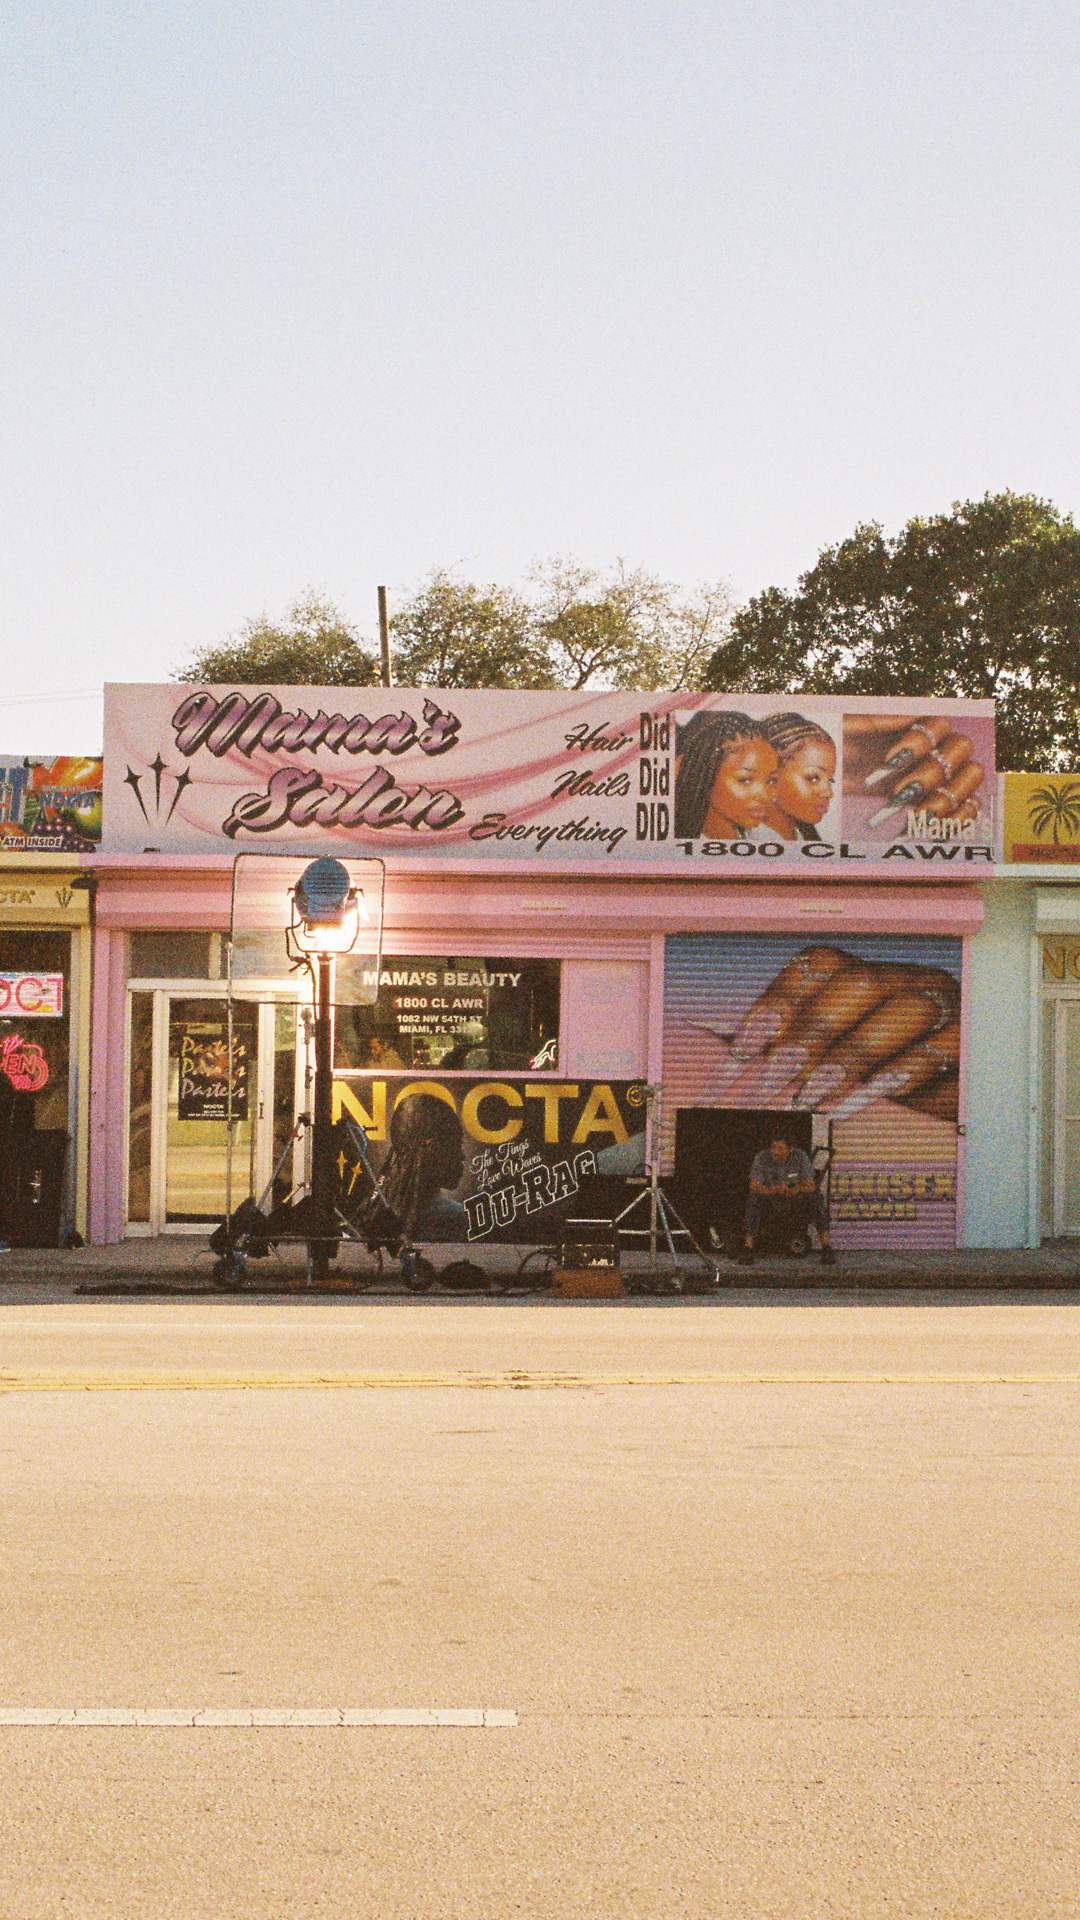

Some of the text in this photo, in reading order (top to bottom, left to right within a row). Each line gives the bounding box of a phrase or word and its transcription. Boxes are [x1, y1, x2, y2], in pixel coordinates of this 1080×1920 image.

[172, 691, 463, 759] Mama's
[564, 712, 671, 752] Hair Did
[550, 757, 671, 800] Nails Did
[222, 765, 466, 840] Salon
[467, 802, 670, 854] Everything DID
[27, 837, 62, 847] INSIDE
[675, 840, 992, 862] 1800 CL AWR
[362, 971, 522, 988] MAMA'S BEAUTY
[395, 997, 484, 1009] 1800 CL AWR
[399, 1025, 433, 1036] MIAMI,
[435, 1026, 449, 1034] FL
[422, 1014, 440, 1023] NW
[441, 1014, 466, 1024] 54TH
[469, 1149, 495, 1176] The
